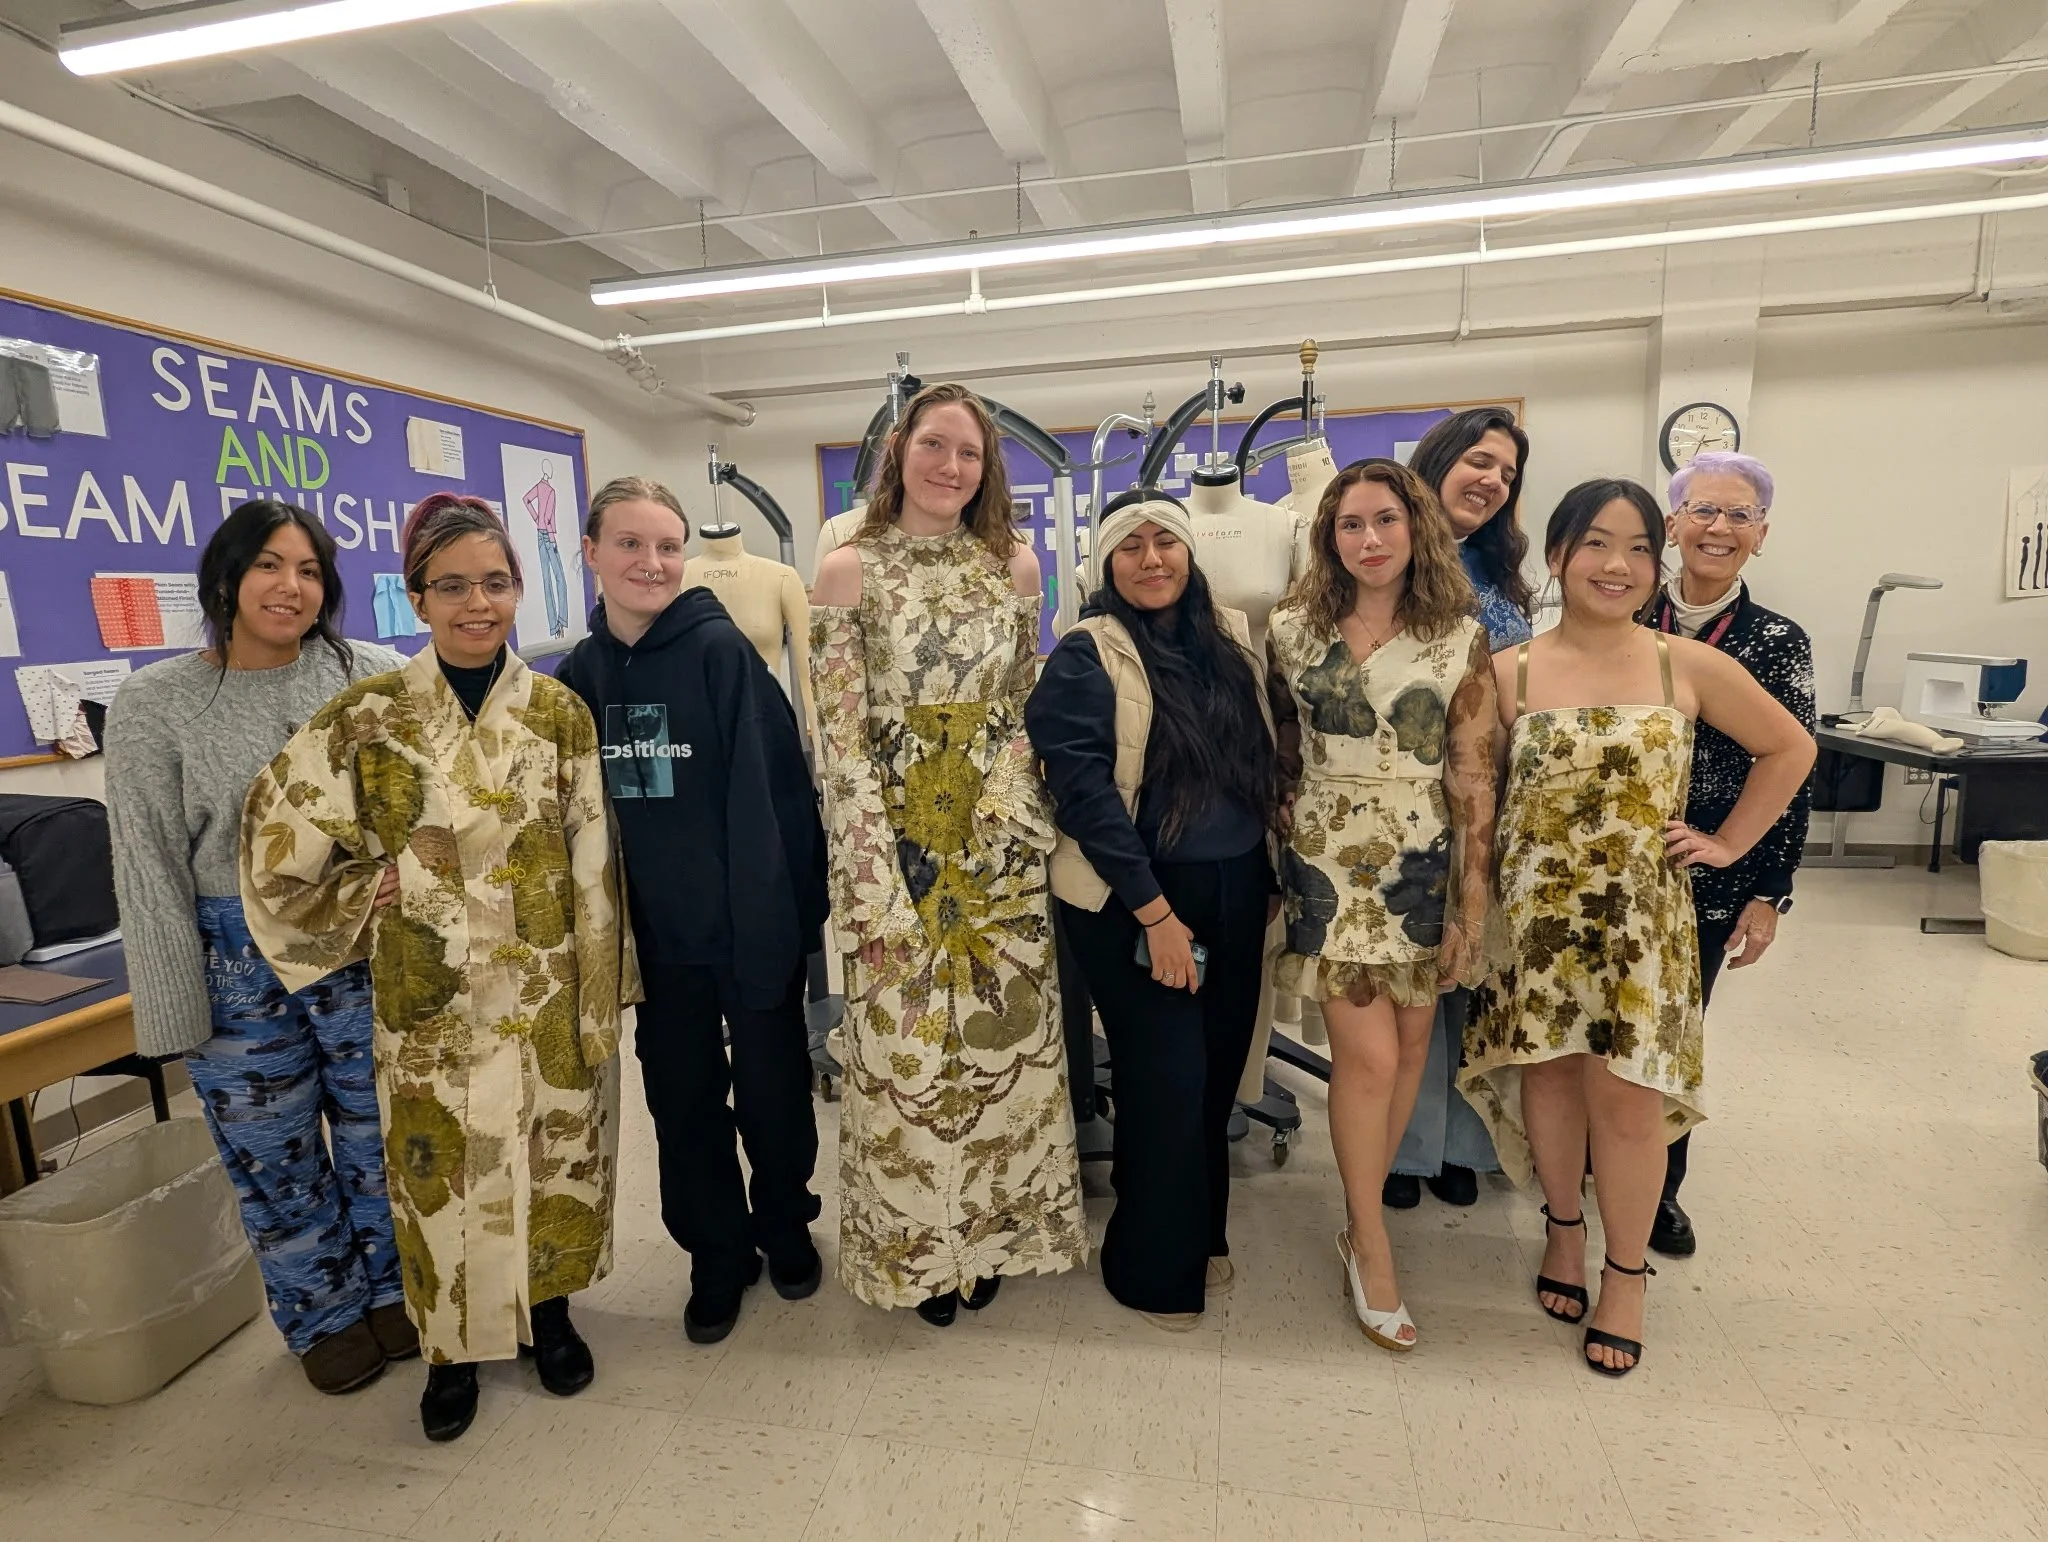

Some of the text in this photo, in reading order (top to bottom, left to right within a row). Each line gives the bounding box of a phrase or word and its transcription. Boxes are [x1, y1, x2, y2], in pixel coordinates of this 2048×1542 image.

[152, 347, 372, 444] SEAMS
[1701, 412, 1708, 420] 12
[216, 425, 330, 490] AND
[0, 462, 196, 546] EAM
[224, 959, 256, 976] YOU
[216, 974, 235, 988] THE
[225, 991, 264, 1009] Back
